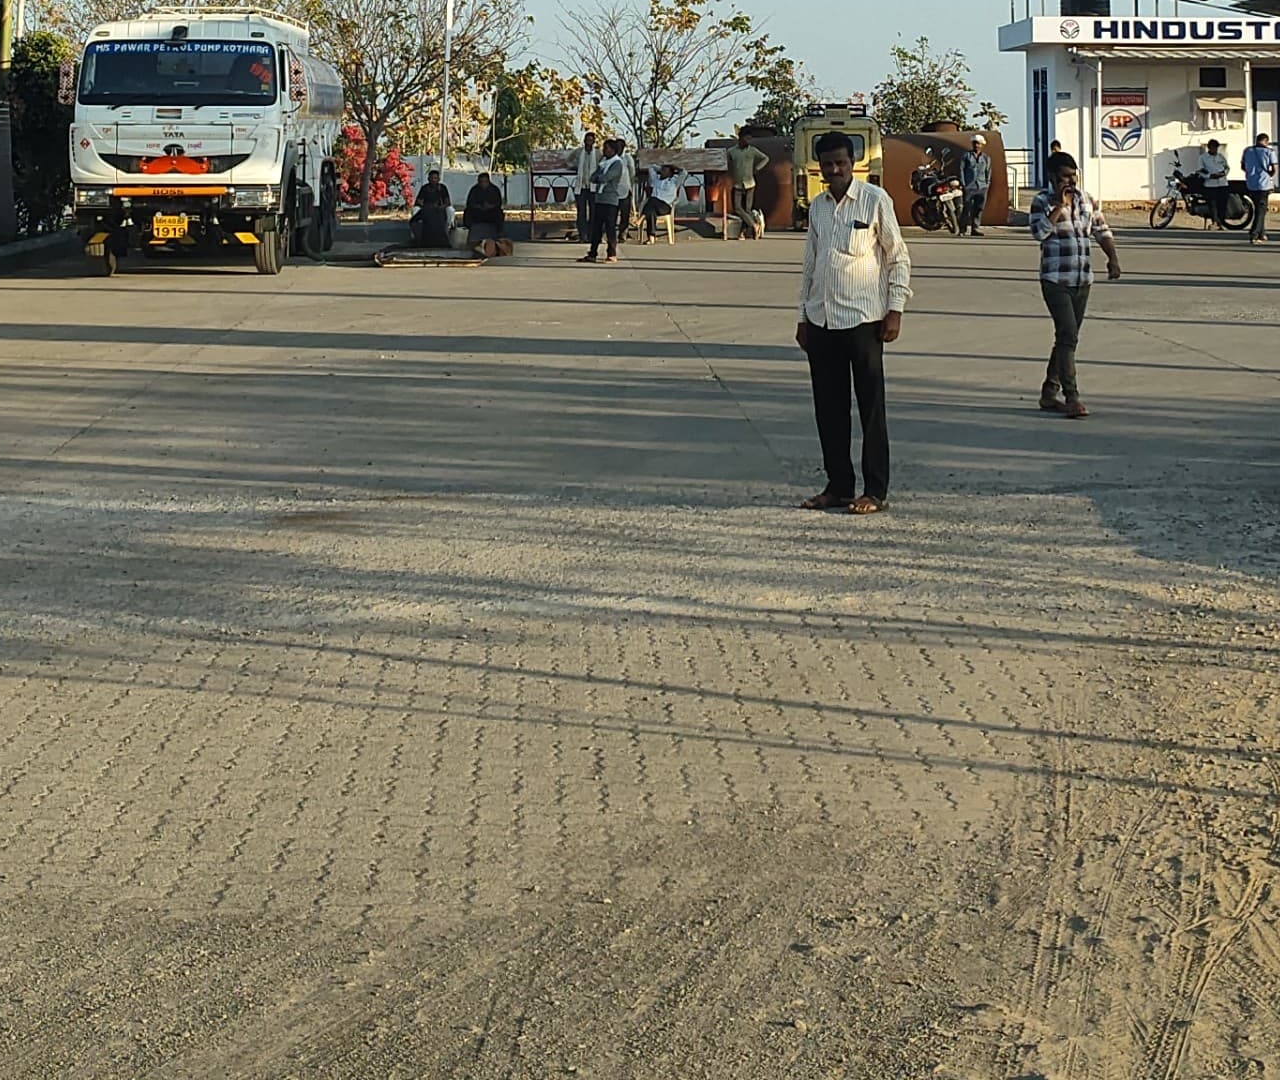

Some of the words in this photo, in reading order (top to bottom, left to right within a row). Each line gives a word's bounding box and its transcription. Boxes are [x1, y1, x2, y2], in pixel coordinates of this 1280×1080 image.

[113, 43, 151, 53] PAWAR
[194, 43, 221, 52] PUMP
[1108, 115, 1134, 128] HP
[163, 131, 185, 139] TATA
[155, 226, 186, 237] 1919
